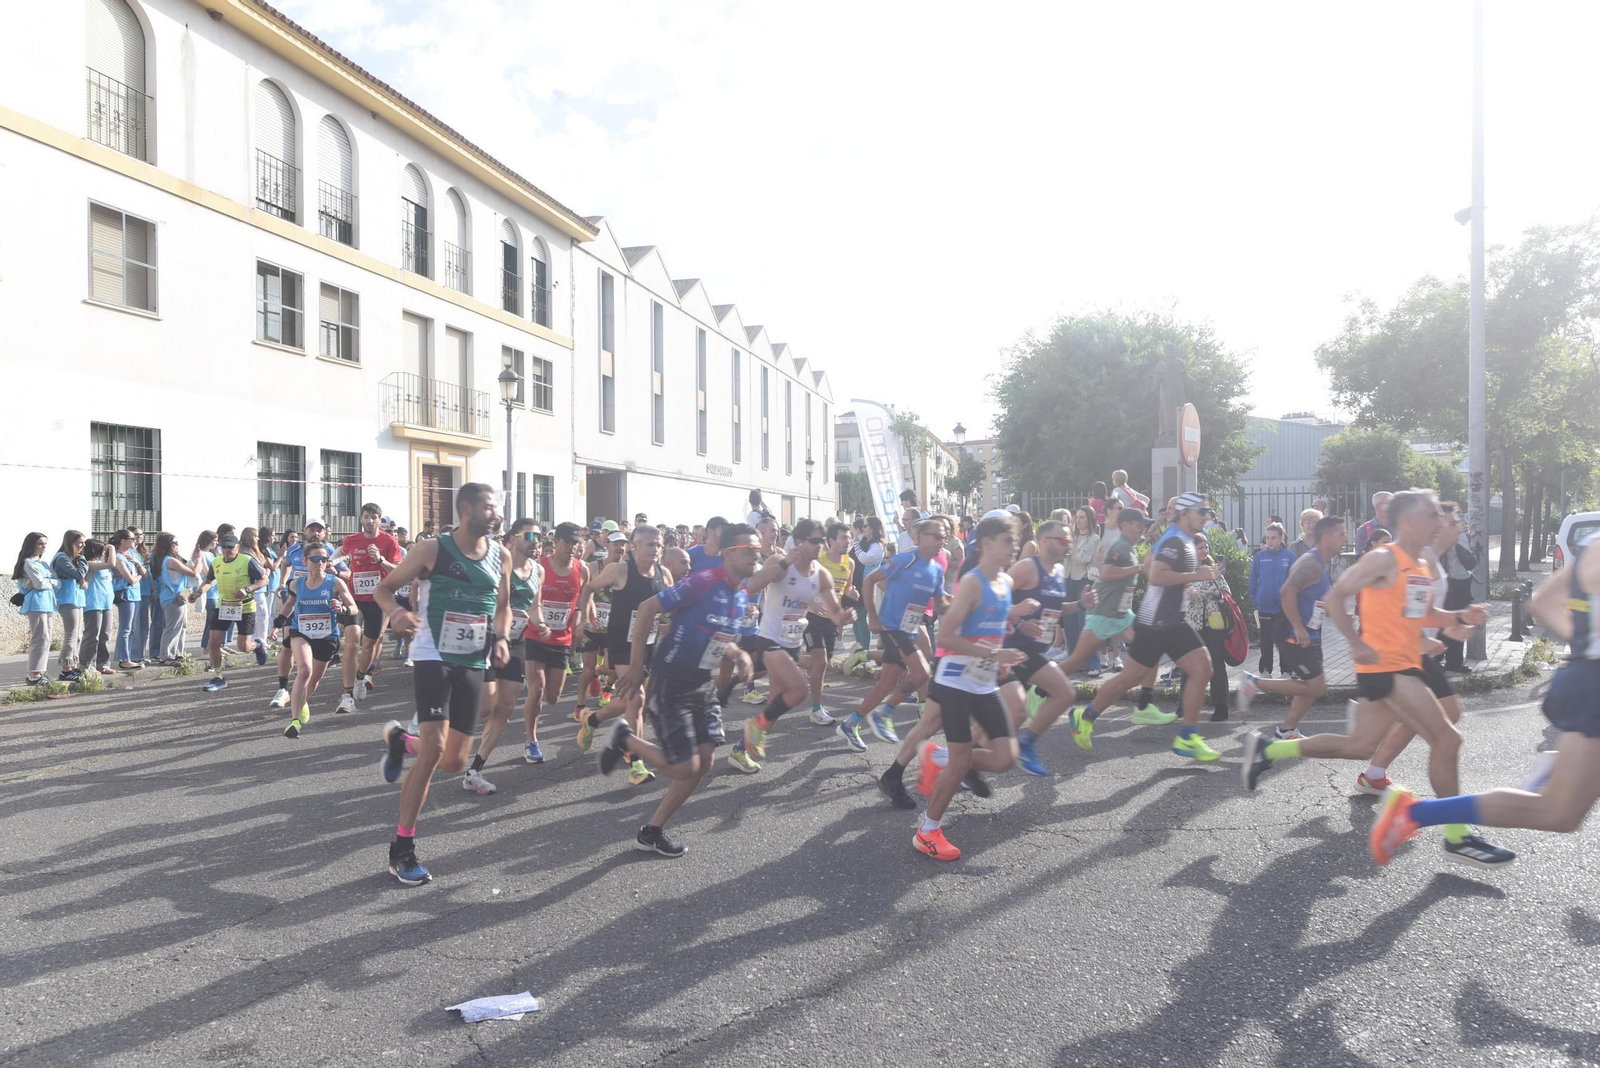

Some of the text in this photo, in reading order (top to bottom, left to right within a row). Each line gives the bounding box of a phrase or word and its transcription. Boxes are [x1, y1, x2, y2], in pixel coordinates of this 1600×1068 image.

[359, 579, 375, 587] 201
[547, 611, 566, 620] 367
[305, 622, 324, 631] 392
[455, 628, 475, 641] 34
